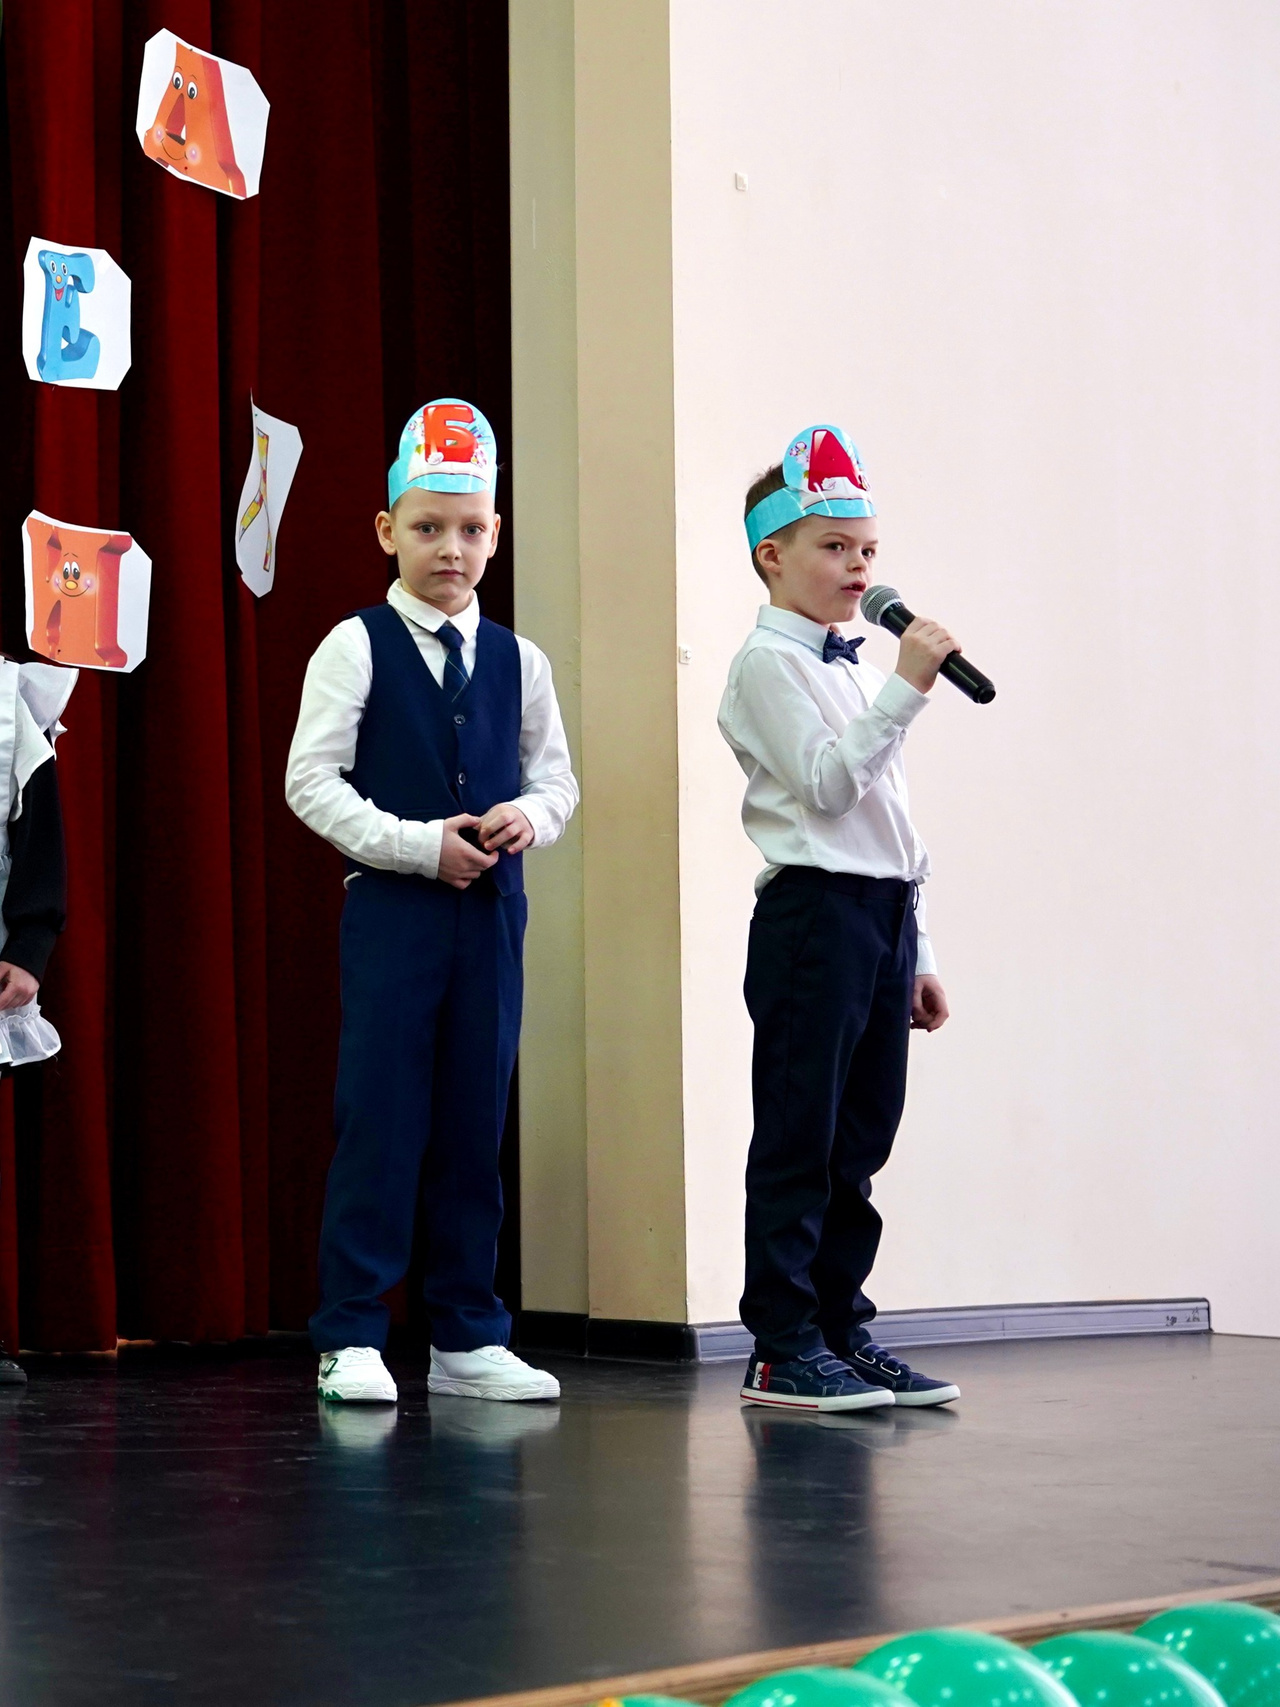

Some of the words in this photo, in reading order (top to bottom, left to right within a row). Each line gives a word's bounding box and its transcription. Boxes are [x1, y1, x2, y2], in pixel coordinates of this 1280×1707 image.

[144, 41, 247, 198] А
[36, 250, 100, 382] Е
[423, 404, 478, 462] Б
[807, 429, 867, 492] А
